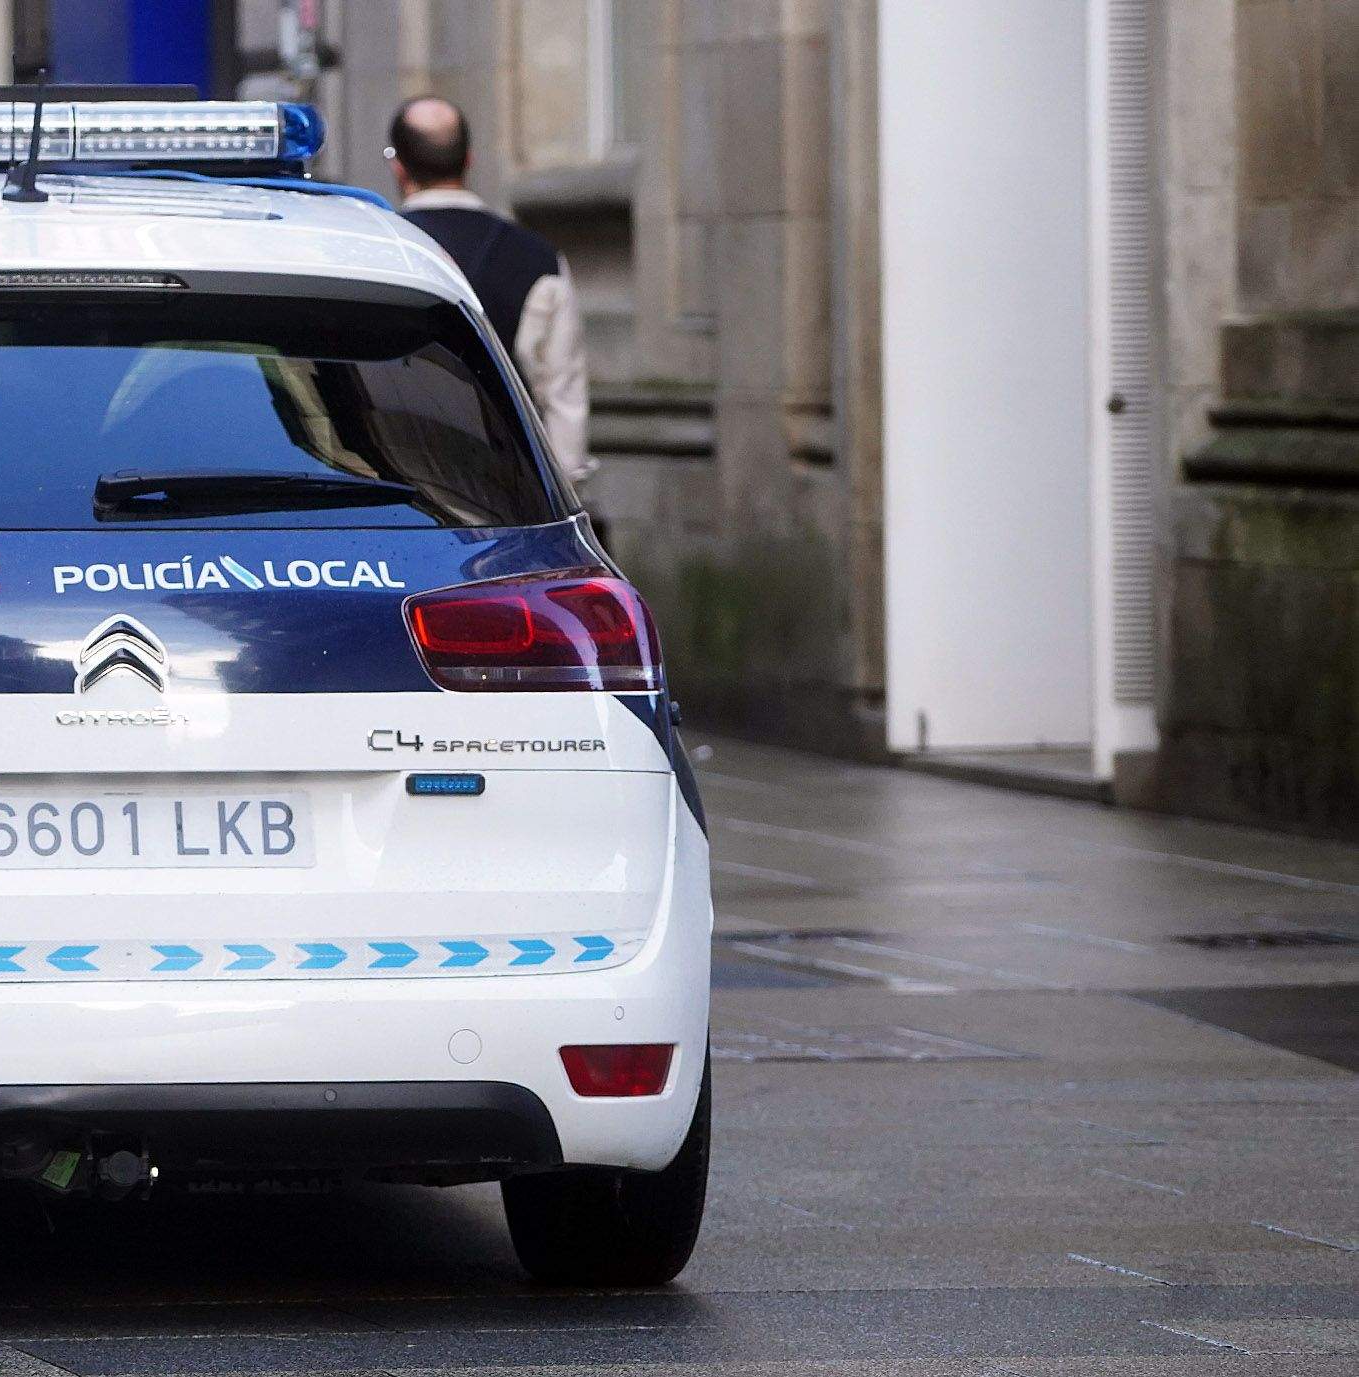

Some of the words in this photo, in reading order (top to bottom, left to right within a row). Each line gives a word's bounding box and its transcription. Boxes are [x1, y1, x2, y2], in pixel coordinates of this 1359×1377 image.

[53, 556, 230, 593] POLICÍA
[264, 560, 405, 589] LOCAL
[367, 729, 424, 752] C4
[432, 738, 606, 753] SPACETOURER
[174, 801, 296, 856] LKB
